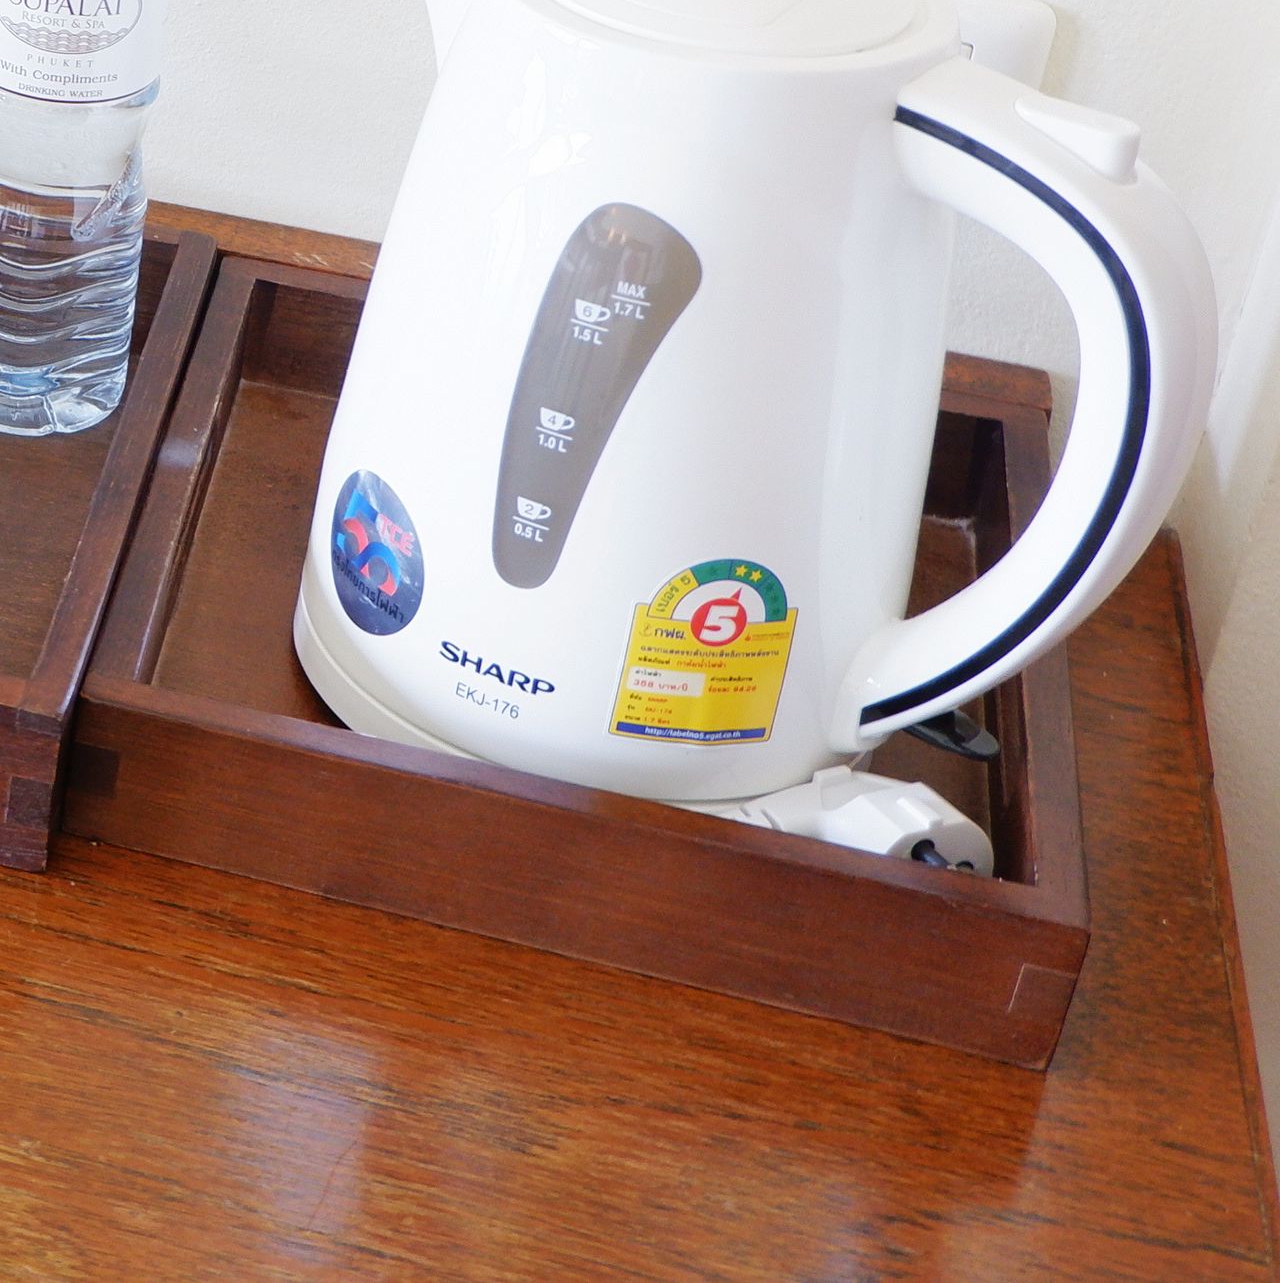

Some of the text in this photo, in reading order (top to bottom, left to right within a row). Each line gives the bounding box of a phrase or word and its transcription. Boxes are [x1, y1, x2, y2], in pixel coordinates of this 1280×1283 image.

[21, 10, 106, 29] RESORT & SPA
[26, 54, 95, 68] PHUKET
[0, 59, 118, 85] With Compliments
[18, 82, 104, 97] DRINKING WATER
[616, 281, 646, 298] MAX
[582, 305, 593, 318] 6
[613, 300, 645, 319] 1.7 L
[573, 326, 603, 345] 1.5 L
[547, 414, 559, 427] 4
[538, 434, 567, 452] 1.0 L
[524, 502, 534, 516] 2
[378, 514, 415, 557] TCE
[514, 522, 543, 543] 0.5 L
[655, 575, 691, 613] เบอร์ 5
[699, 605, 739, 642] 5
[654, 627, 686, 640] กฟผ.
[439, 641, 557, 698] SHARP
[454, 681, 521, 721] EKJ-176
